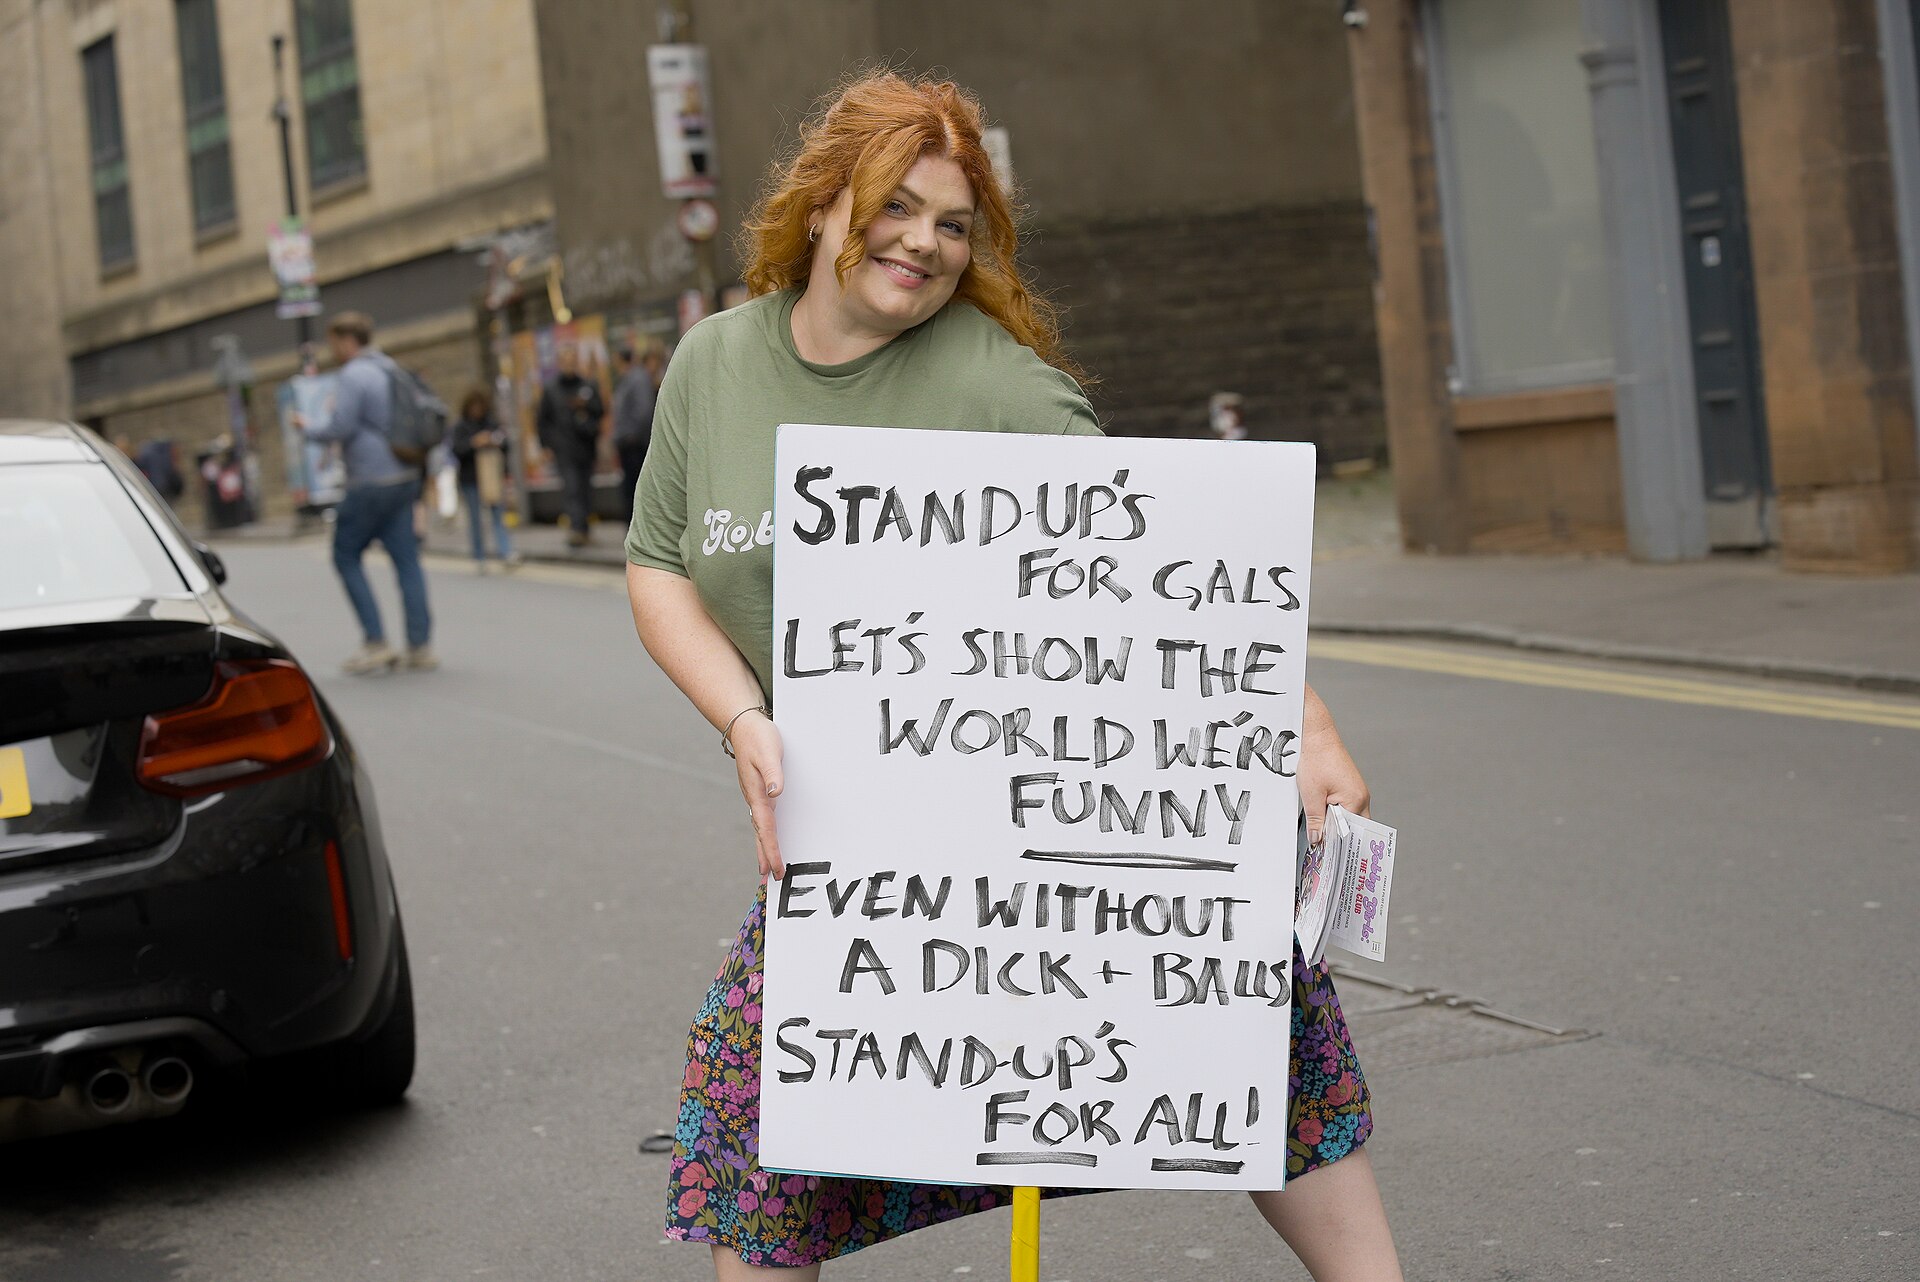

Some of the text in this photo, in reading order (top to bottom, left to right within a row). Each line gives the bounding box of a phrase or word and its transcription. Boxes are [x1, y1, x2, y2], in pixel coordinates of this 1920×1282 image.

[794, 465, 1155, 547] STAND-UP'S
[1018, 549, 1300, 611] FOR GALS
[784, 612, 1286, 698] LET'S SHOW THE
[879, 698, 1298, 777] WORLD WE'RE
[1010, 772, 1250, 844] FUNNY
[778, 861, 952, 921] EVEN
[975, 876, 1251, 942] WITHOUT
[1354, 858, 1368, 914] THE 11% CLUB
[1365, 840, 1385, 893] Gobby
[839, 938, 896, 995] A
[922, 939, 1088, 999] DICK
[1153, 953, 1290, 1007] BALLS
[777, 1017, 1136, 1089] STAND-UP'S
[985, 1087, 1260, 1151] FOR ALL!
